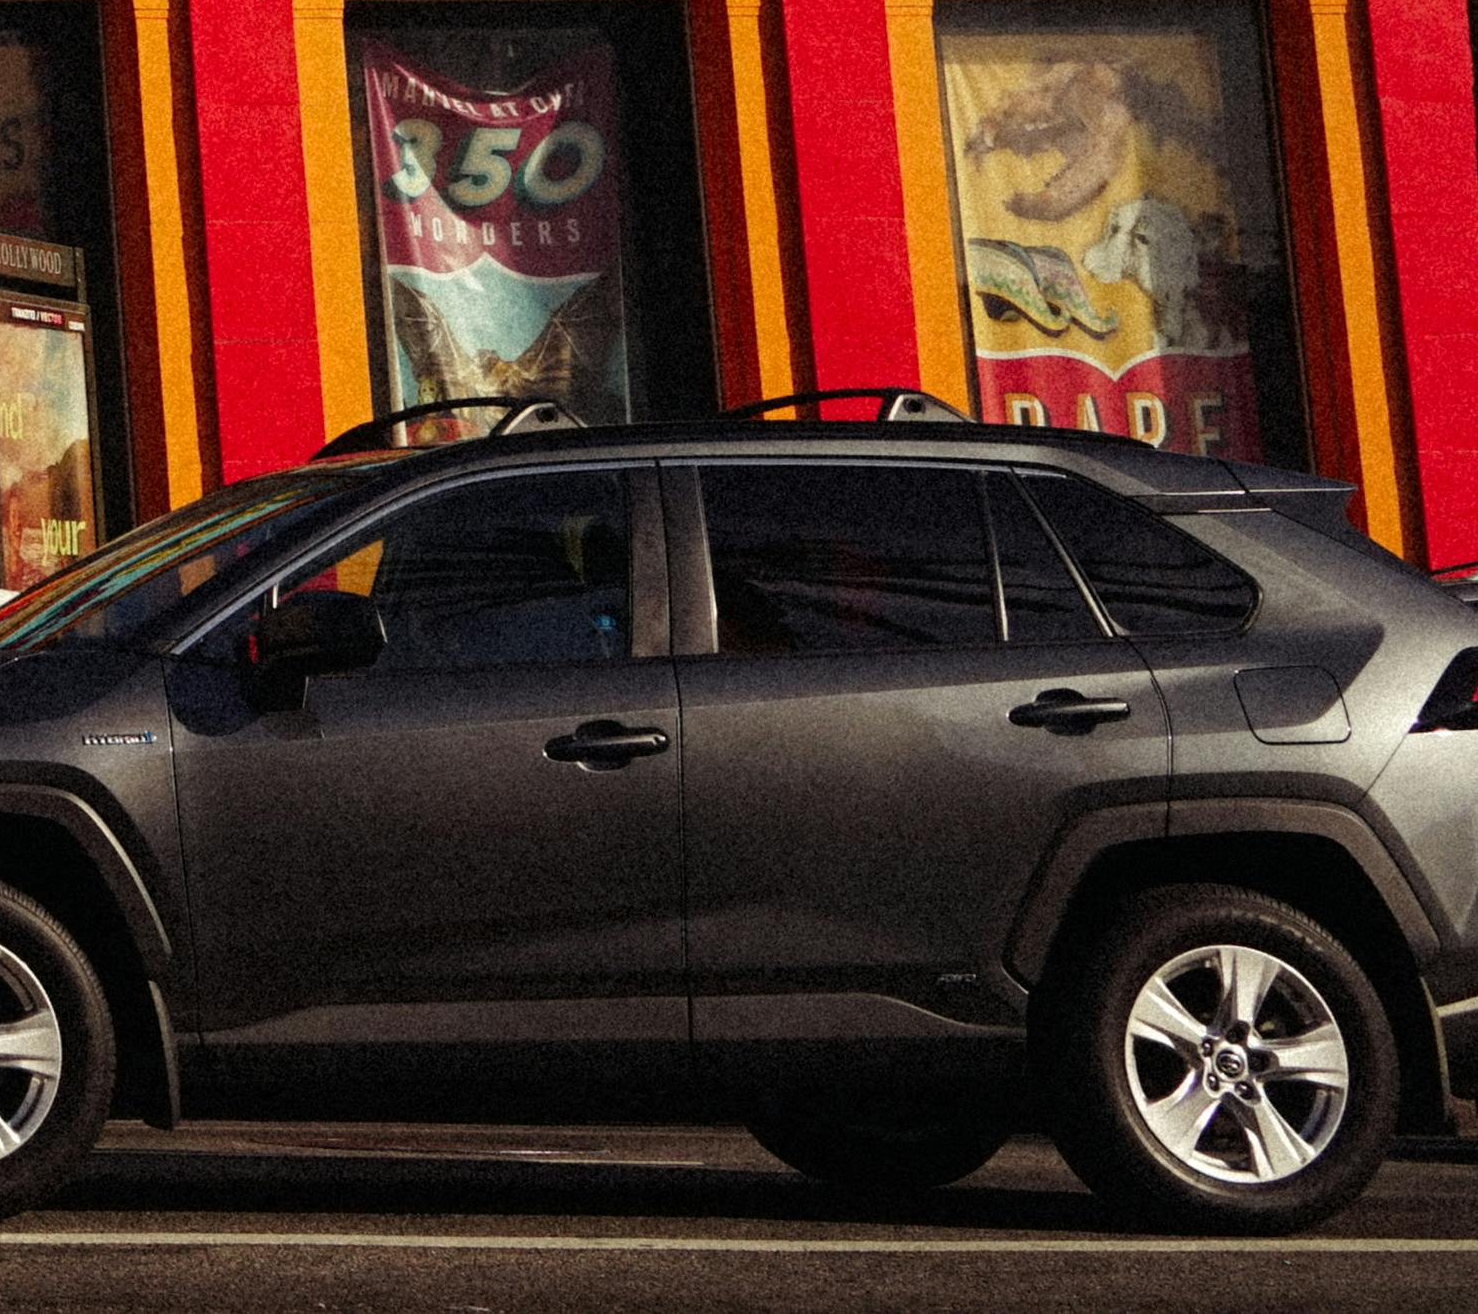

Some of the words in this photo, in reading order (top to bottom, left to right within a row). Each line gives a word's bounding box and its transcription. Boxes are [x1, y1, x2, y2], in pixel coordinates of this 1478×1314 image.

[387, 118, 606, 207] 350
[409, 212, 581, 247] WONDERS
[41, 518, 86, 566] your
